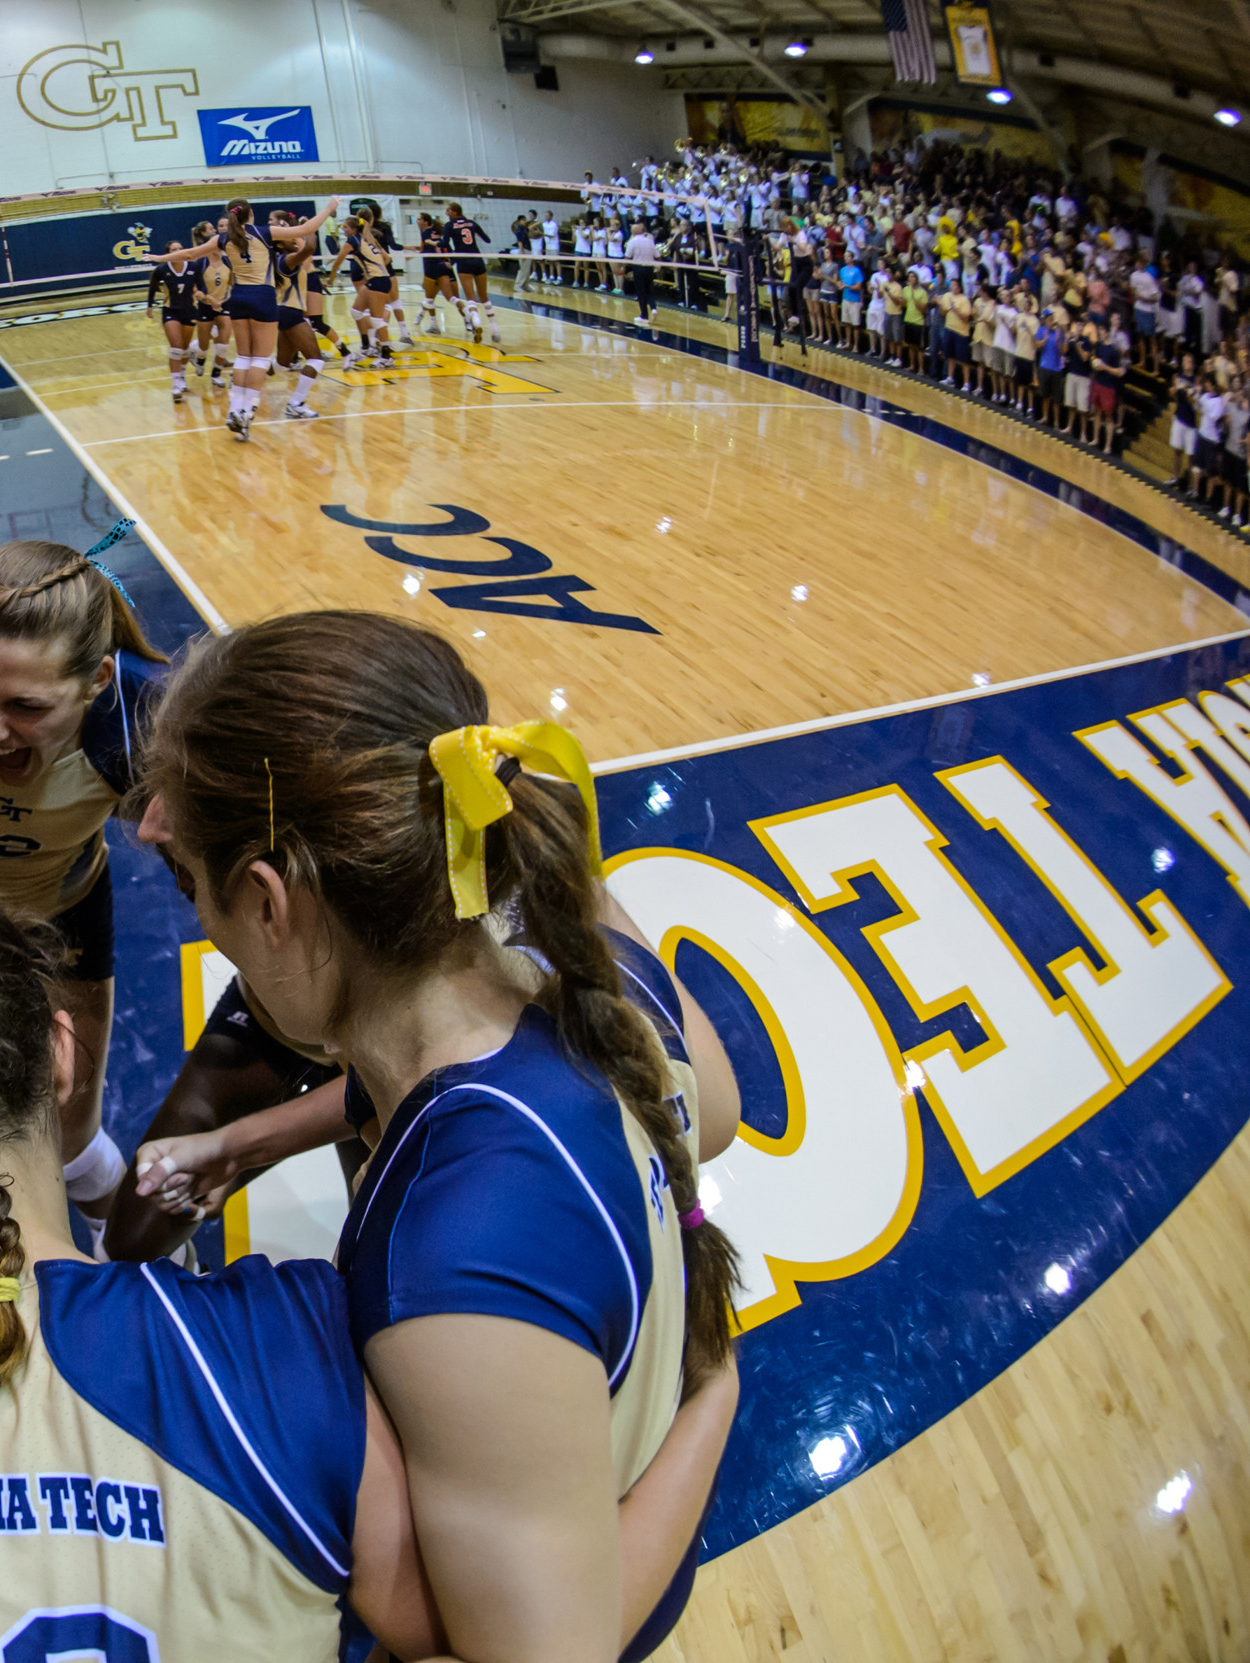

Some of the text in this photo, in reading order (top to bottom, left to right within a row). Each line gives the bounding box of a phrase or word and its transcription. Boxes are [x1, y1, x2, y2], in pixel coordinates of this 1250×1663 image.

[461, 228, 474, 245] 3
[113, 240, 151, 261] GT
[177, 283, 186, 294] 7
[215, 276, 222, 287] 6
[319, 504, 663, 636] ACC
[39, 1472, 166, 1548] TECH
